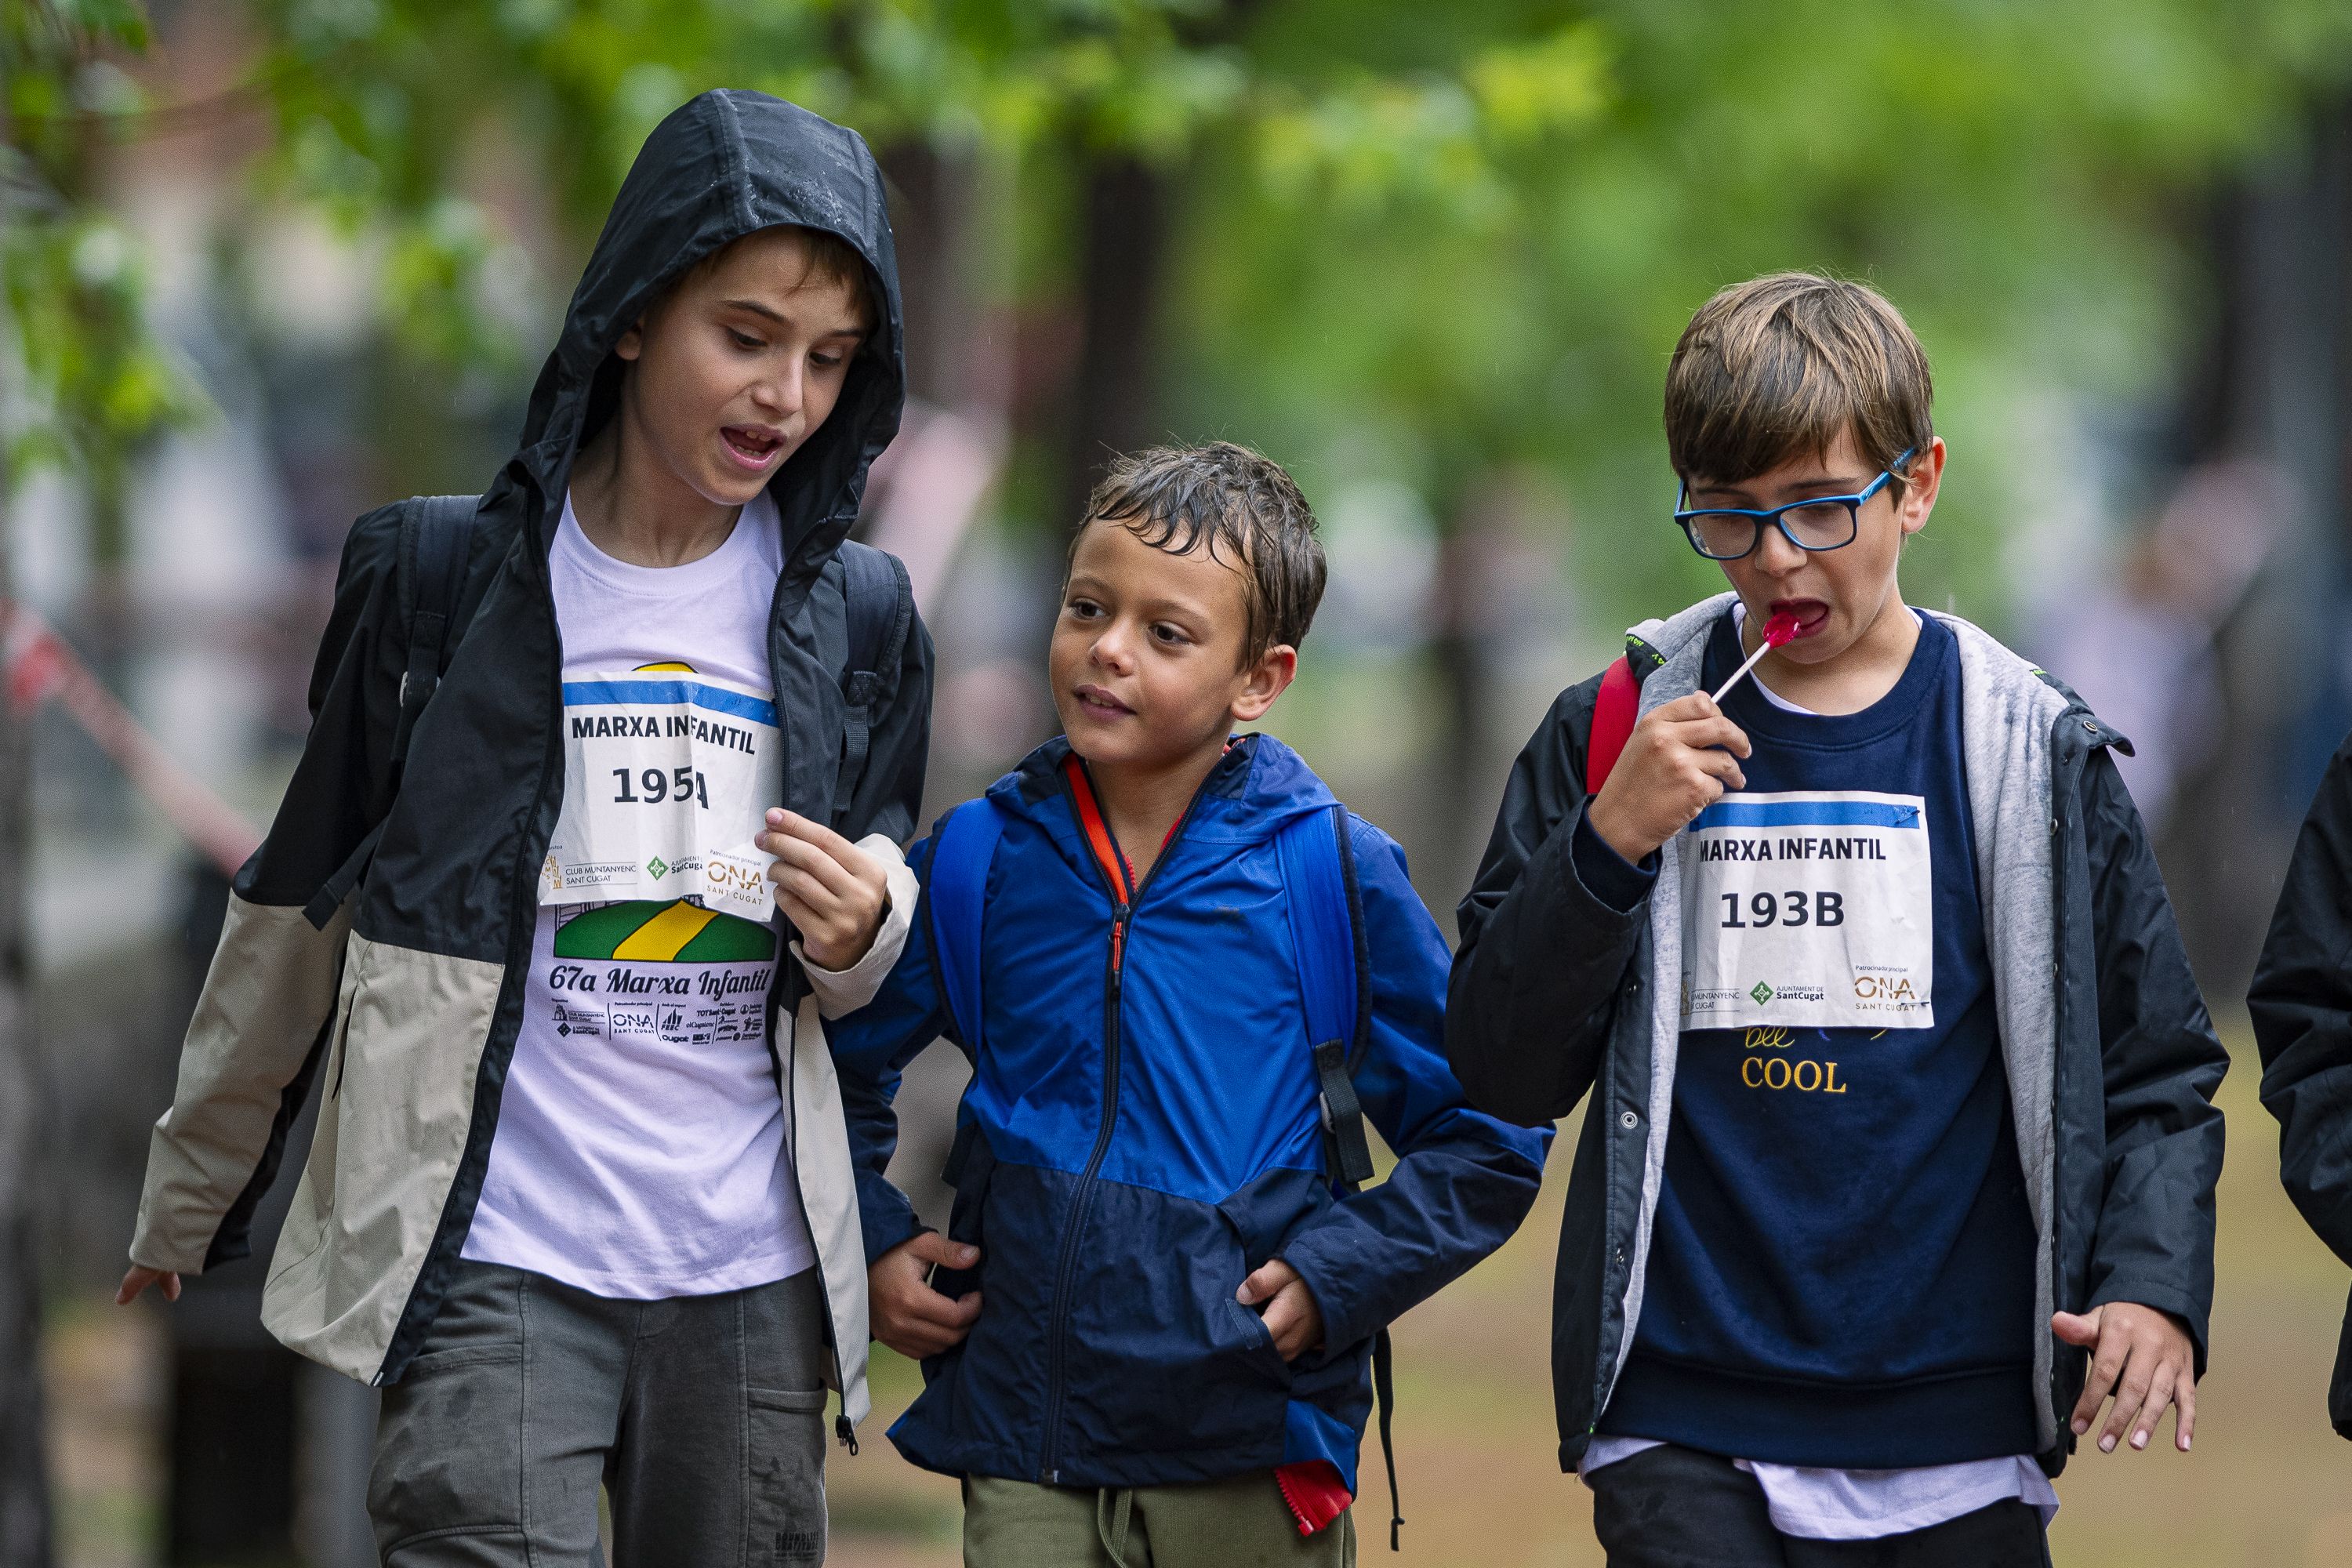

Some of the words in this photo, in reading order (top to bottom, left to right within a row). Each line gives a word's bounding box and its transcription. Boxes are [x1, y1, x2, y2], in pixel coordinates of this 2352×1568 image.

[572, 717, 660, 739] MARXA
[666, 714, 755, 755] INFANTIL
[612, 765, 710, 809] 195A
[710, 848, 740, 861] Patrocinador
[740, 857, 762, 866] principal
[1700, 838, 1773, 862] MARXA
[1779, 837, 1886, 860] INFANTIL
[566, 876, 585, 884] SANT
[586, 874, 611, 883] CUGAT
[584, 865, 637, 873] MUNTANYENC
[708, 861, 764, 895] ONA
[707, 885, 730, 898] SANT
[733, 891, 763, 906] CUGAT
[1721, 891, 1845, 928] 193B
[550, 964, 597, 993] 67a
[606, 967, 691, 995] Marxa
[698, 968, 771, 1001] Infantil
[1855, 976, 1915, 999] ONA
[1695, 1001, 1715, 1010] CUGAT
[1777, 991, 1824, 1001] SantCugat
[613, 1014, 654, 1029] ONA
[1742, 1057, 1846, 1093] COOL
